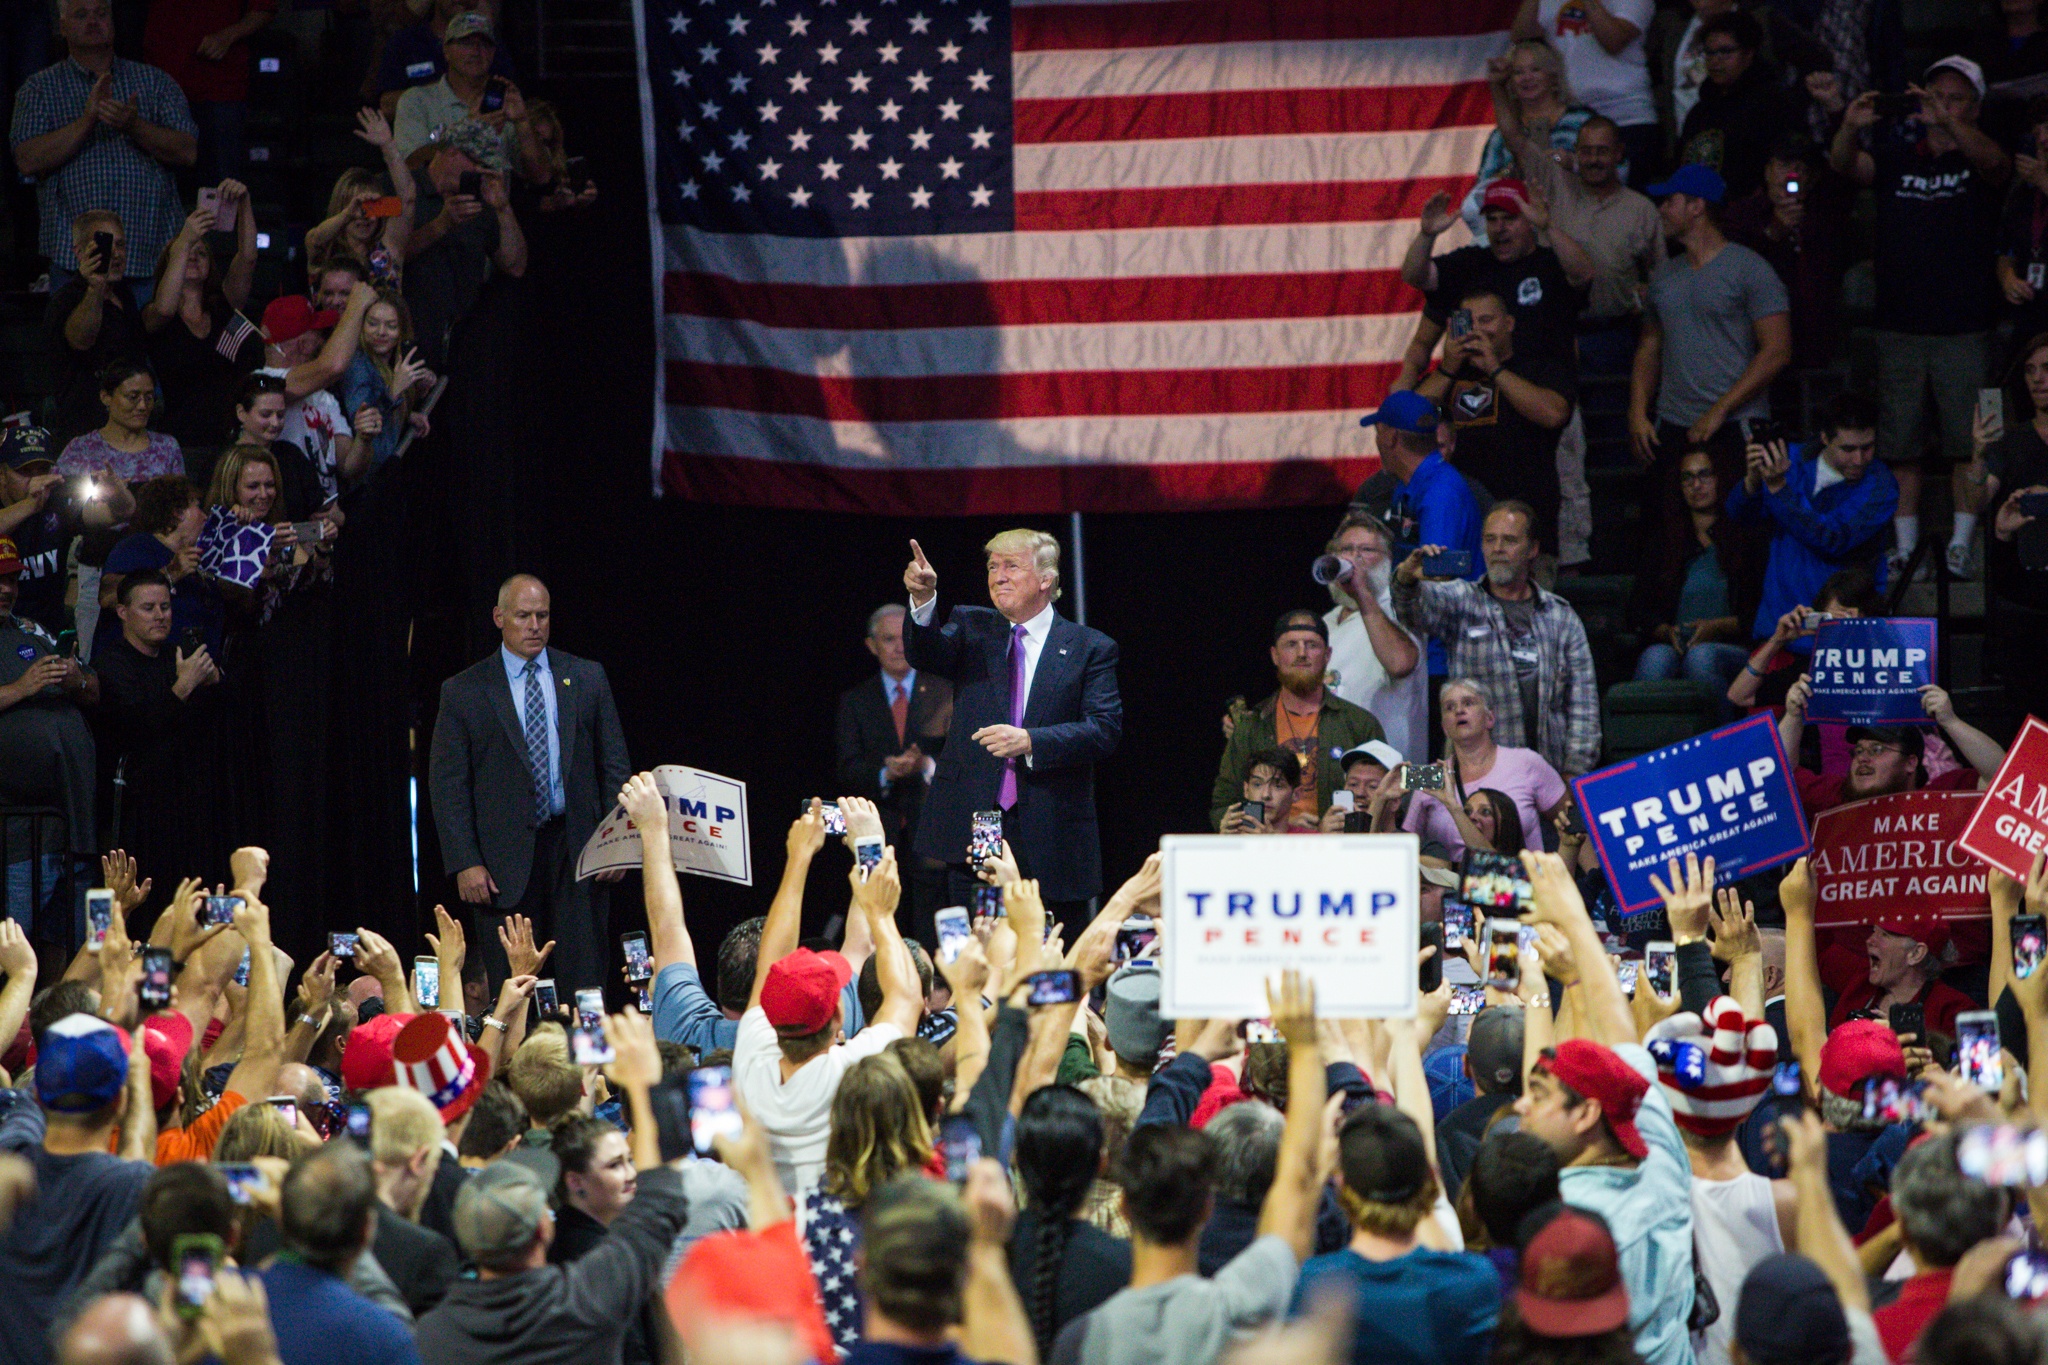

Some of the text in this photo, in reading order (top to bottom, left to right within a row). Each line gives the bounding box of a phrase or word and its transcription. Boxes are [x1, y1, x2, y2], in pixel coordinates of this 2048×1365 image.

[19, 549, 58, 580] AVY
[1815, 648, 1927, 668] TRUMP
[1815, 671, 1912, 684] PENCE
[1831, 687, 1860, 695] AMERICA
[1861, 687, 1886, 695] GREAT
[1852, 717, 1871, 725] 2016
[1598, 756, 1776, 837] TRUMP
[601, 820, 723, 840] PECE
[1625, 792, 1769, 856] PENCE
[1873, 813, 1940, 834] MAKE
[1628, 812, 1778, 871] MAKE AMERICA GREAT AGAIN!
[1815, 839, 1985, 876] AMERIC
[1821, 877, 1899, 902] GREAT
[1186, 892, 1397, 918] TRUMP
[1204, 929, 1375, 945] PENCE
